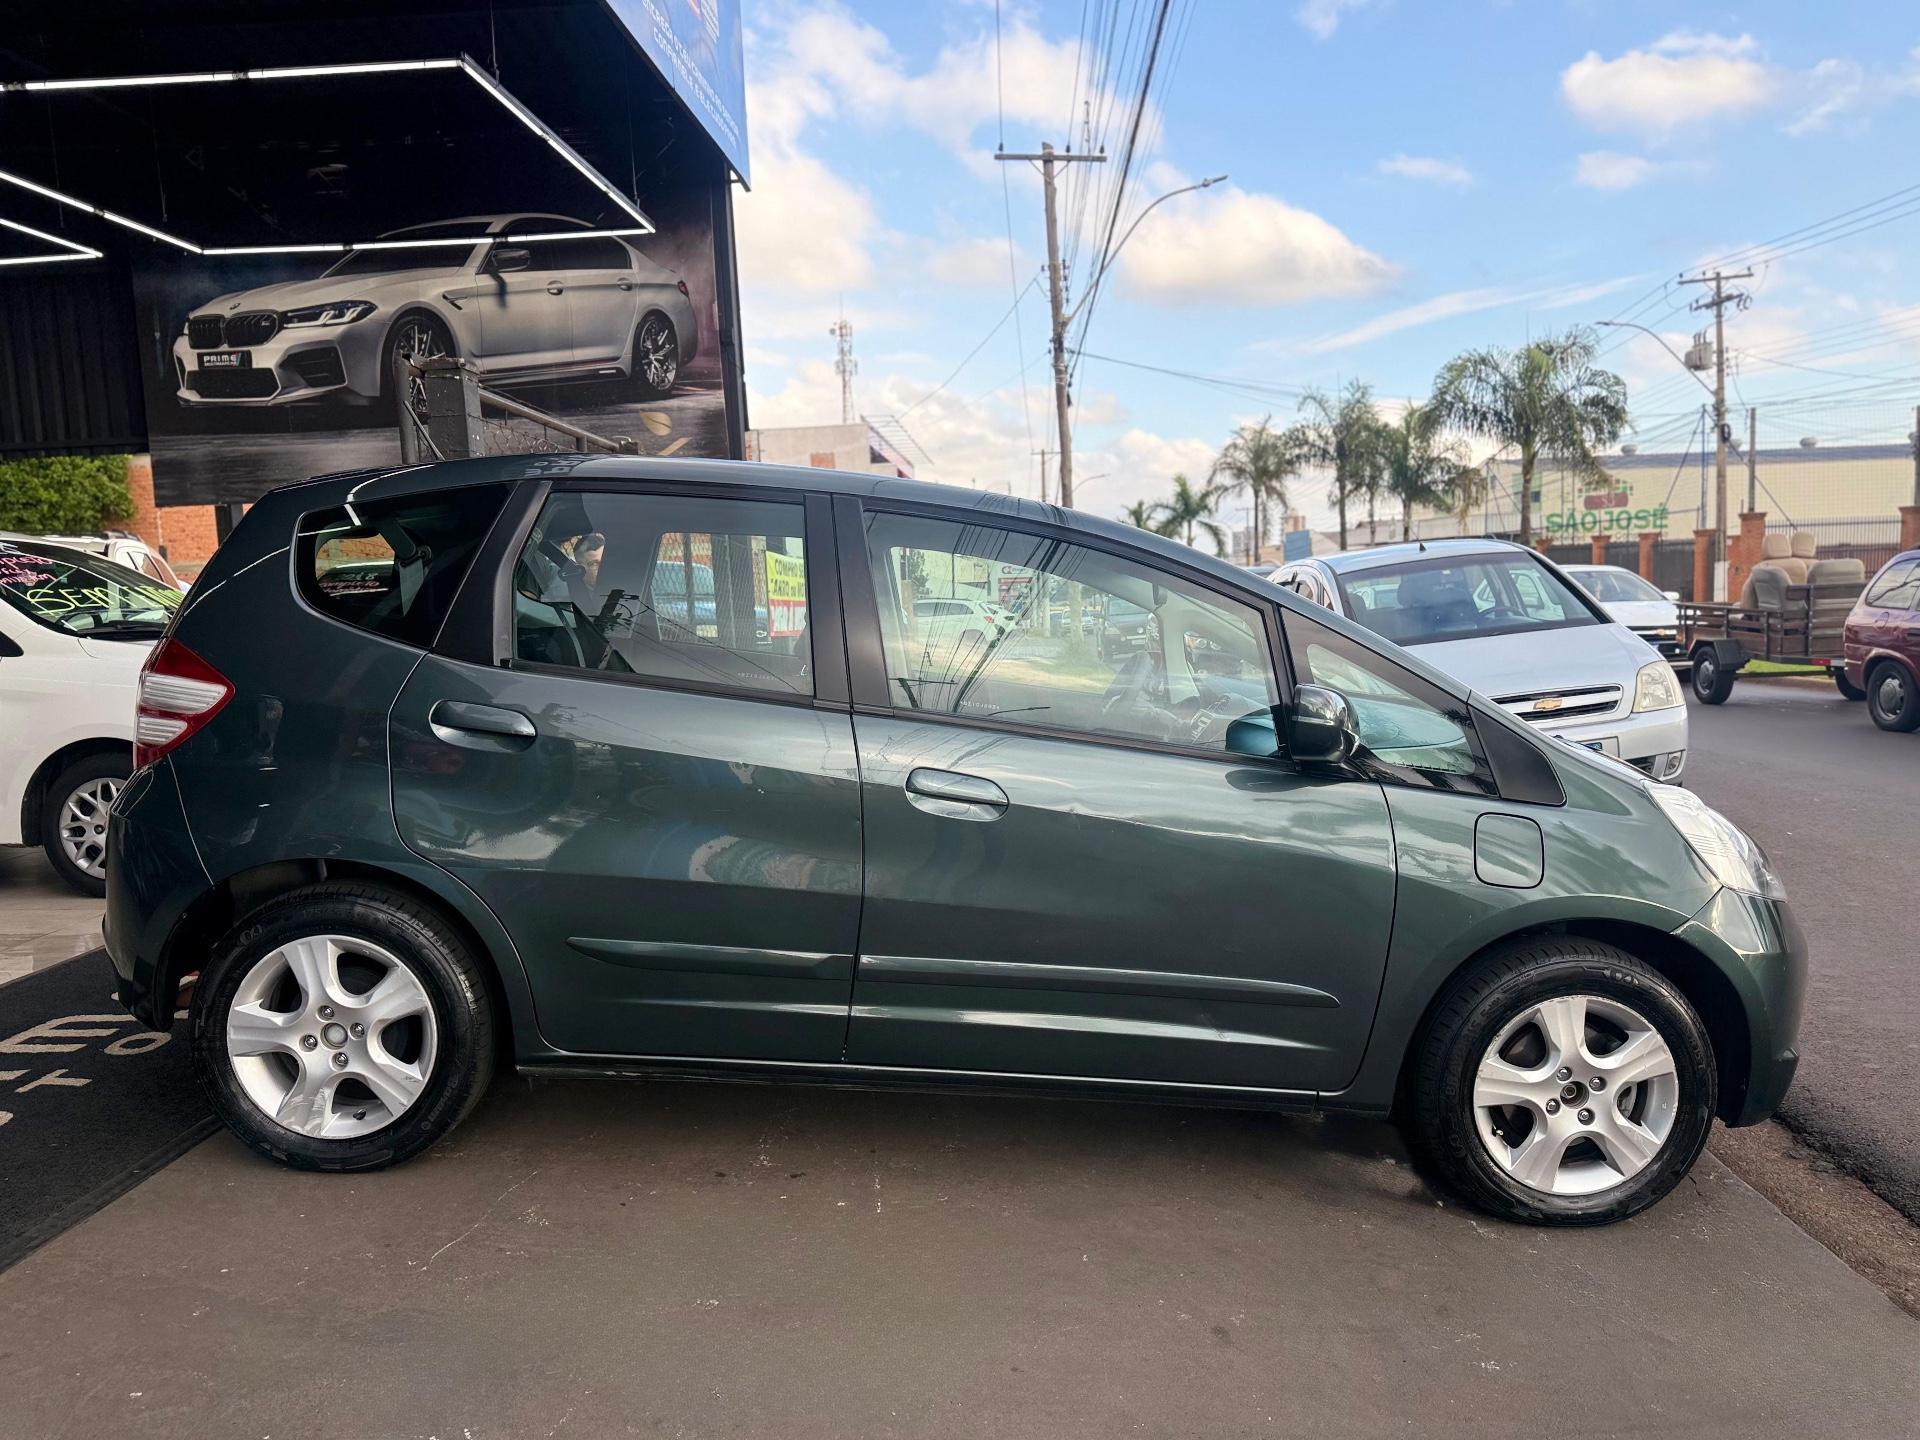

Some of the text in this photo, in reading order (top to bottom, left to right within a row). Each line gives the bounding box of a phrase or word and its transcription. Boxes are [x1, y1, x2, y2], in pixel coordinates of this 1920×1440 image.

[203, 354, 237, 362] PRIME
[1546, 502, 1669, 533] SÃO JOSÉ
